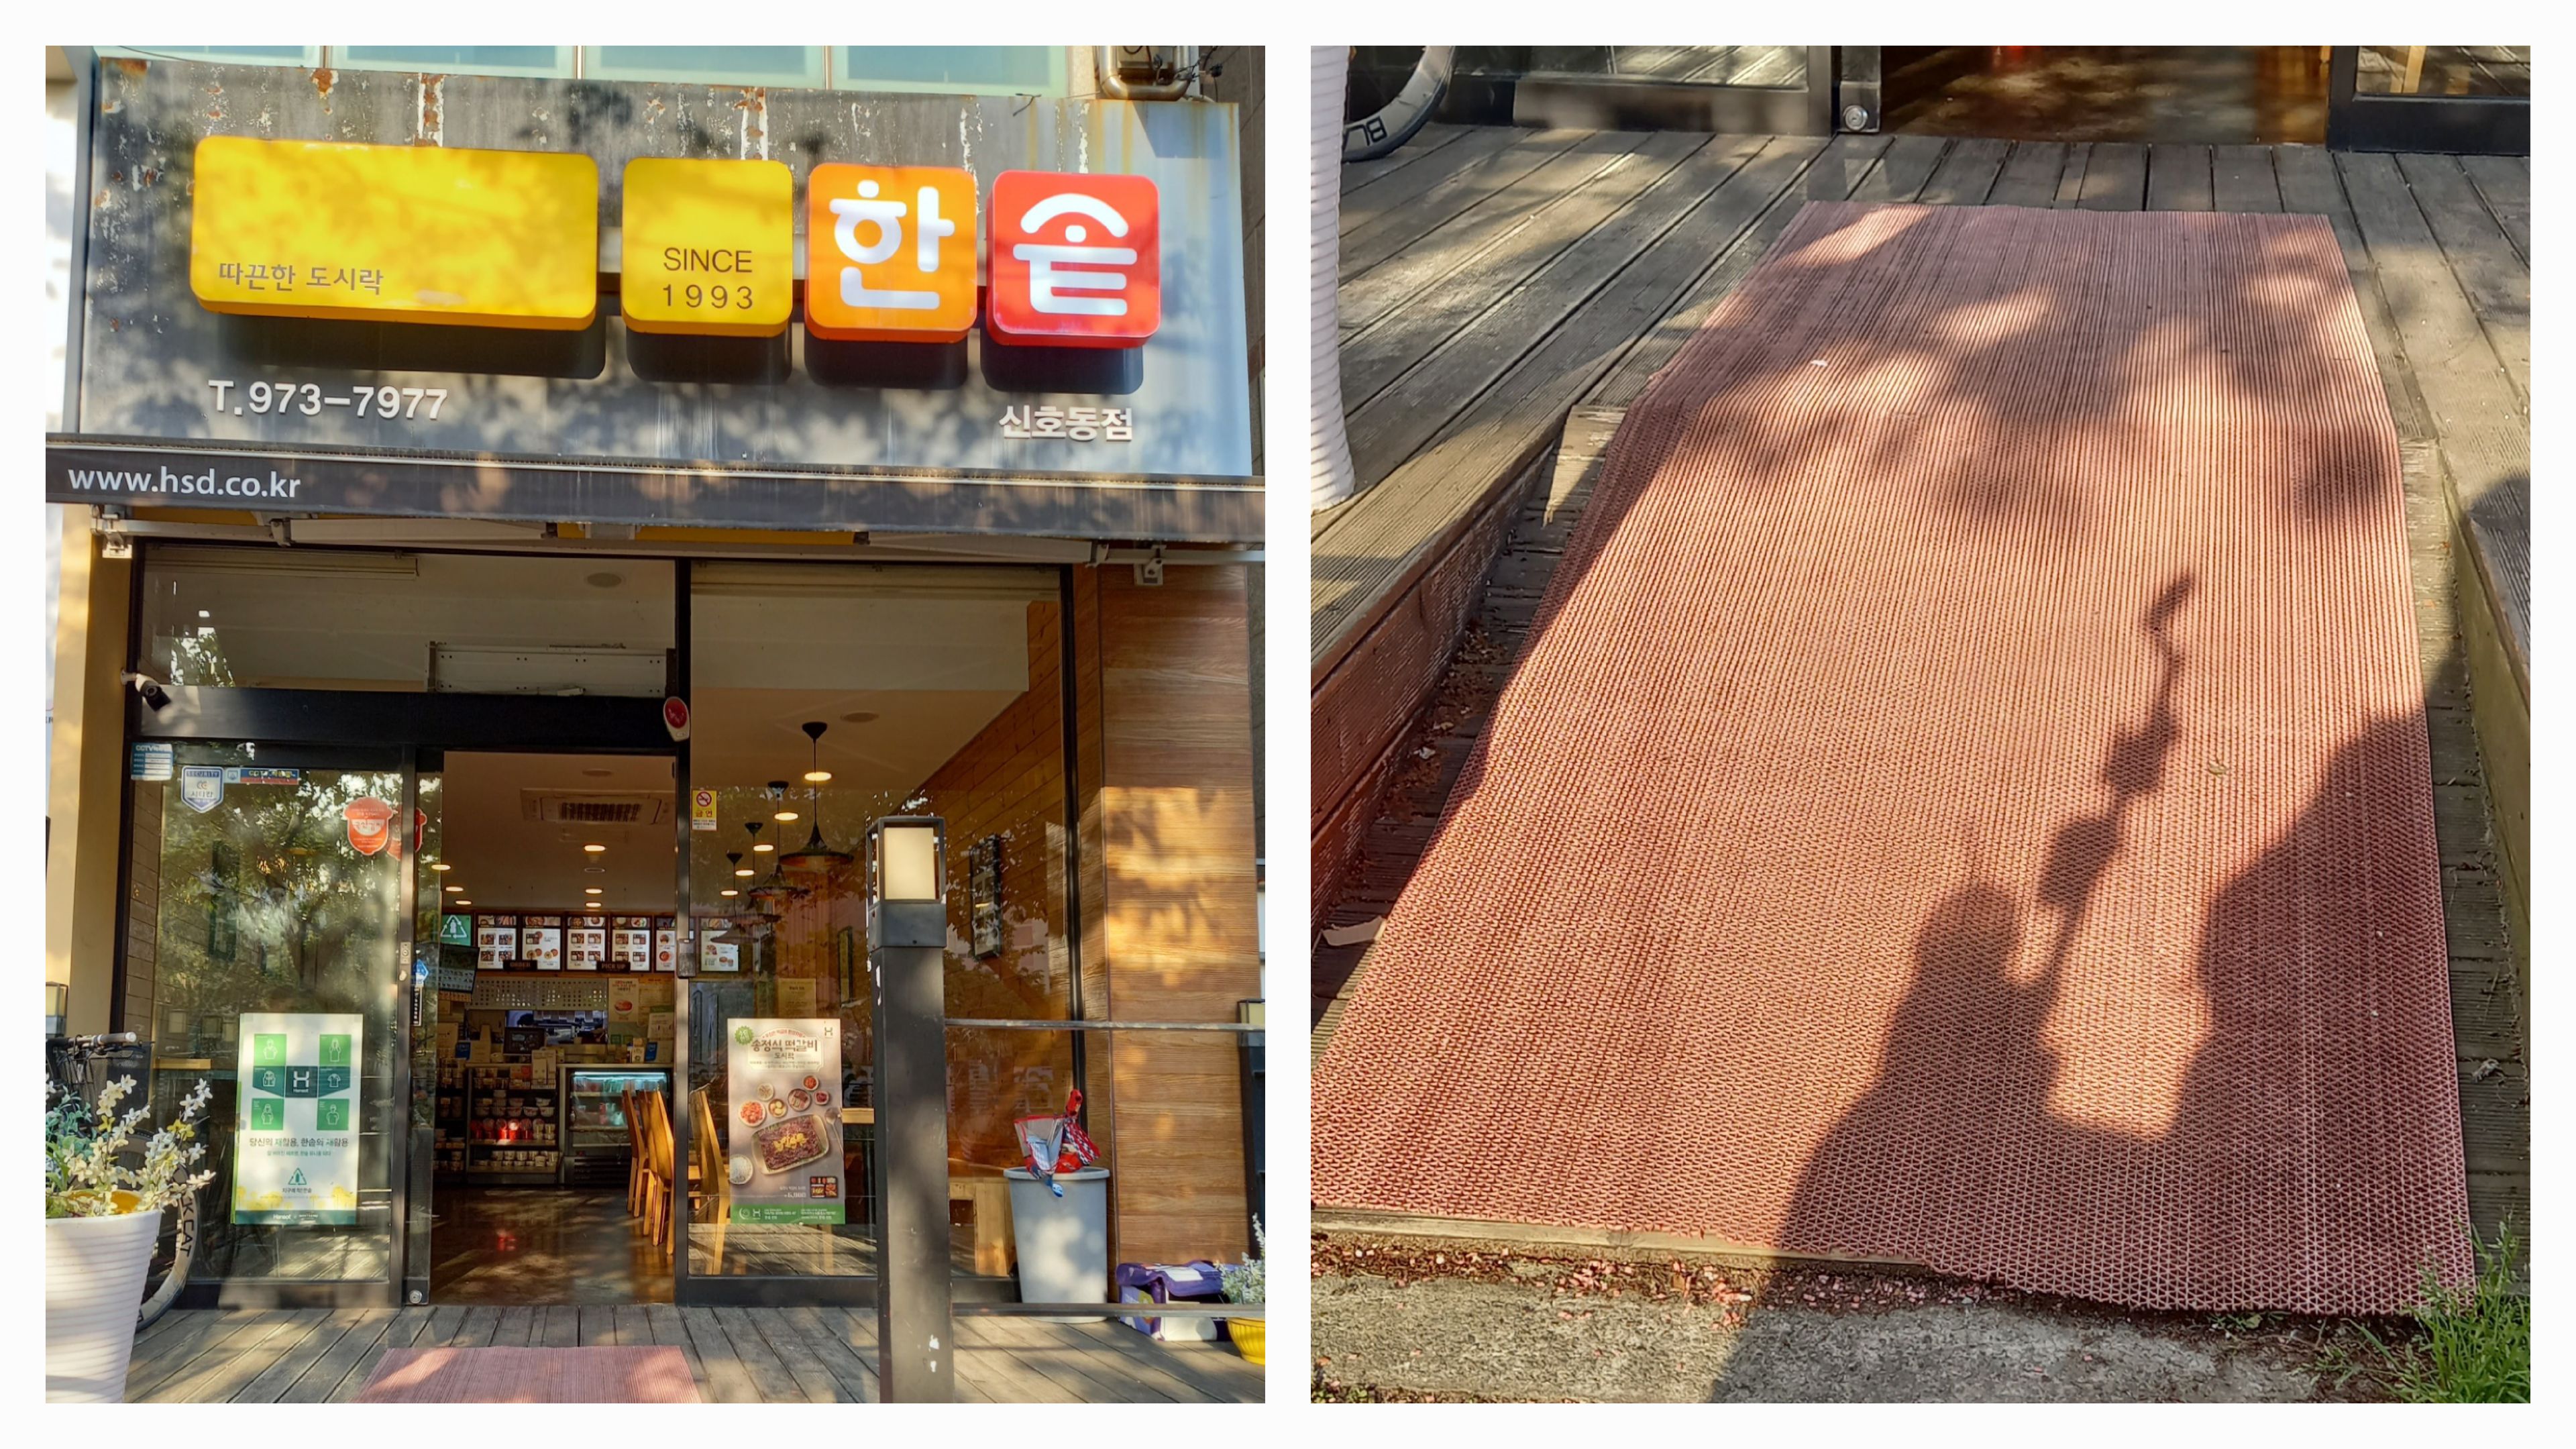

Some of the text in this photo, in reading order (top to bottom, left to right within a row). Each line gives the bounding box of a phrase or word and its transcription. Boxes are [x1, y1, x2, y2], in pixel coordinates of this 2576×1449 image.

[1342, 115, 1387, 151] BL
[663, 246, 753, 273] SINCE
[219, 262, 384, 295] 따끈한 도시락
[663, 284, 753, 309] 1993
[999, 405, 1133, 441] 신호동점
[68, 466, 301, 498] www.hsd.co.kr
[751, 1039, 818, 1052] 송정식 떡갈비
